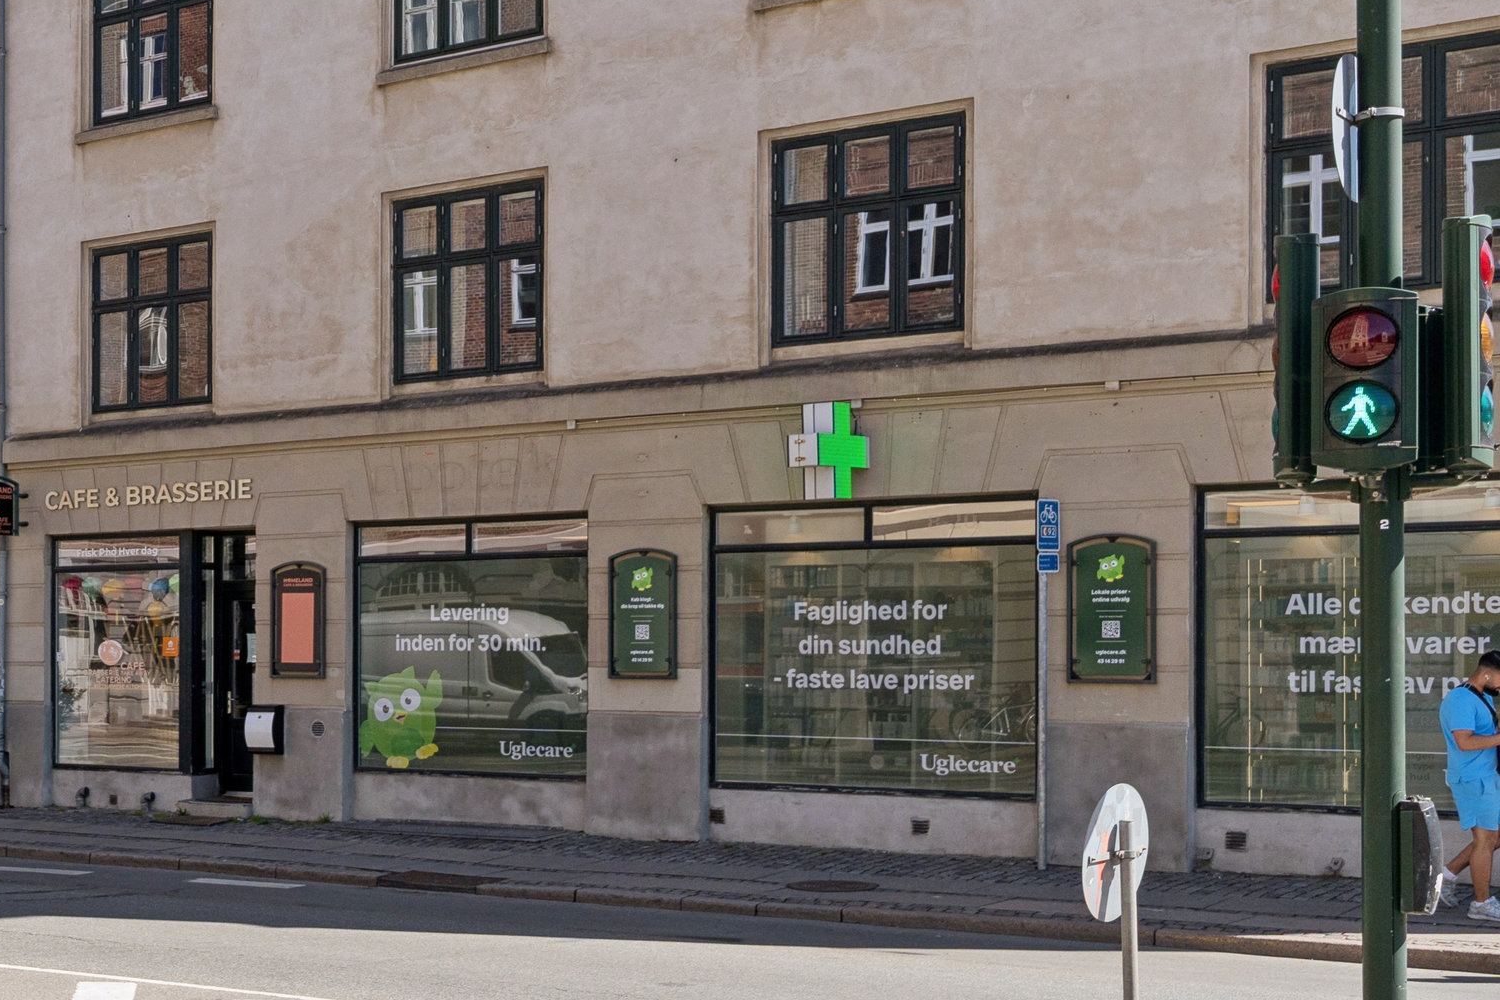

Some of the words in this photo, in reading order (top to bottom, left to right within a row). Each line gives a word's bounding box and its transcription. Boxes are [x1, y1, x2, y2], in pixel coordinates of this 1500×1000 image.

[45, 488, 100, 510] CAFE
[106, 487, 119, 507] &
[126, 479, 252, 506] BRASSERIE
[1379, 519, 1390, 529] 2
[141, 546, 158, 557] dag
[430, 603, 509, 625] Levering
[794, 600, 907, 625] Faglighed
[912, 600, 948, 621] for
[1285, 593, 1342, 615] Alle
[395, 634, 445, 652] inden
[448, 633, 474, 652] for
[478, 634, 502, 652] 30
[506, 633, 547, 652] min.
[798, 635, 833, 655] din
[838, 635, 941, 655] sundhed
[120, 662, 146, 670] CAFE
[786, 669, 844, 689] faste
[850, 669, 898, 690] lave
[904, 669, 975, 694] priser
[1288, 670, 1316, 693] til
[499, 741, 573, 760] Uglecare
[920, 754, 1017, 776] Uglecare
